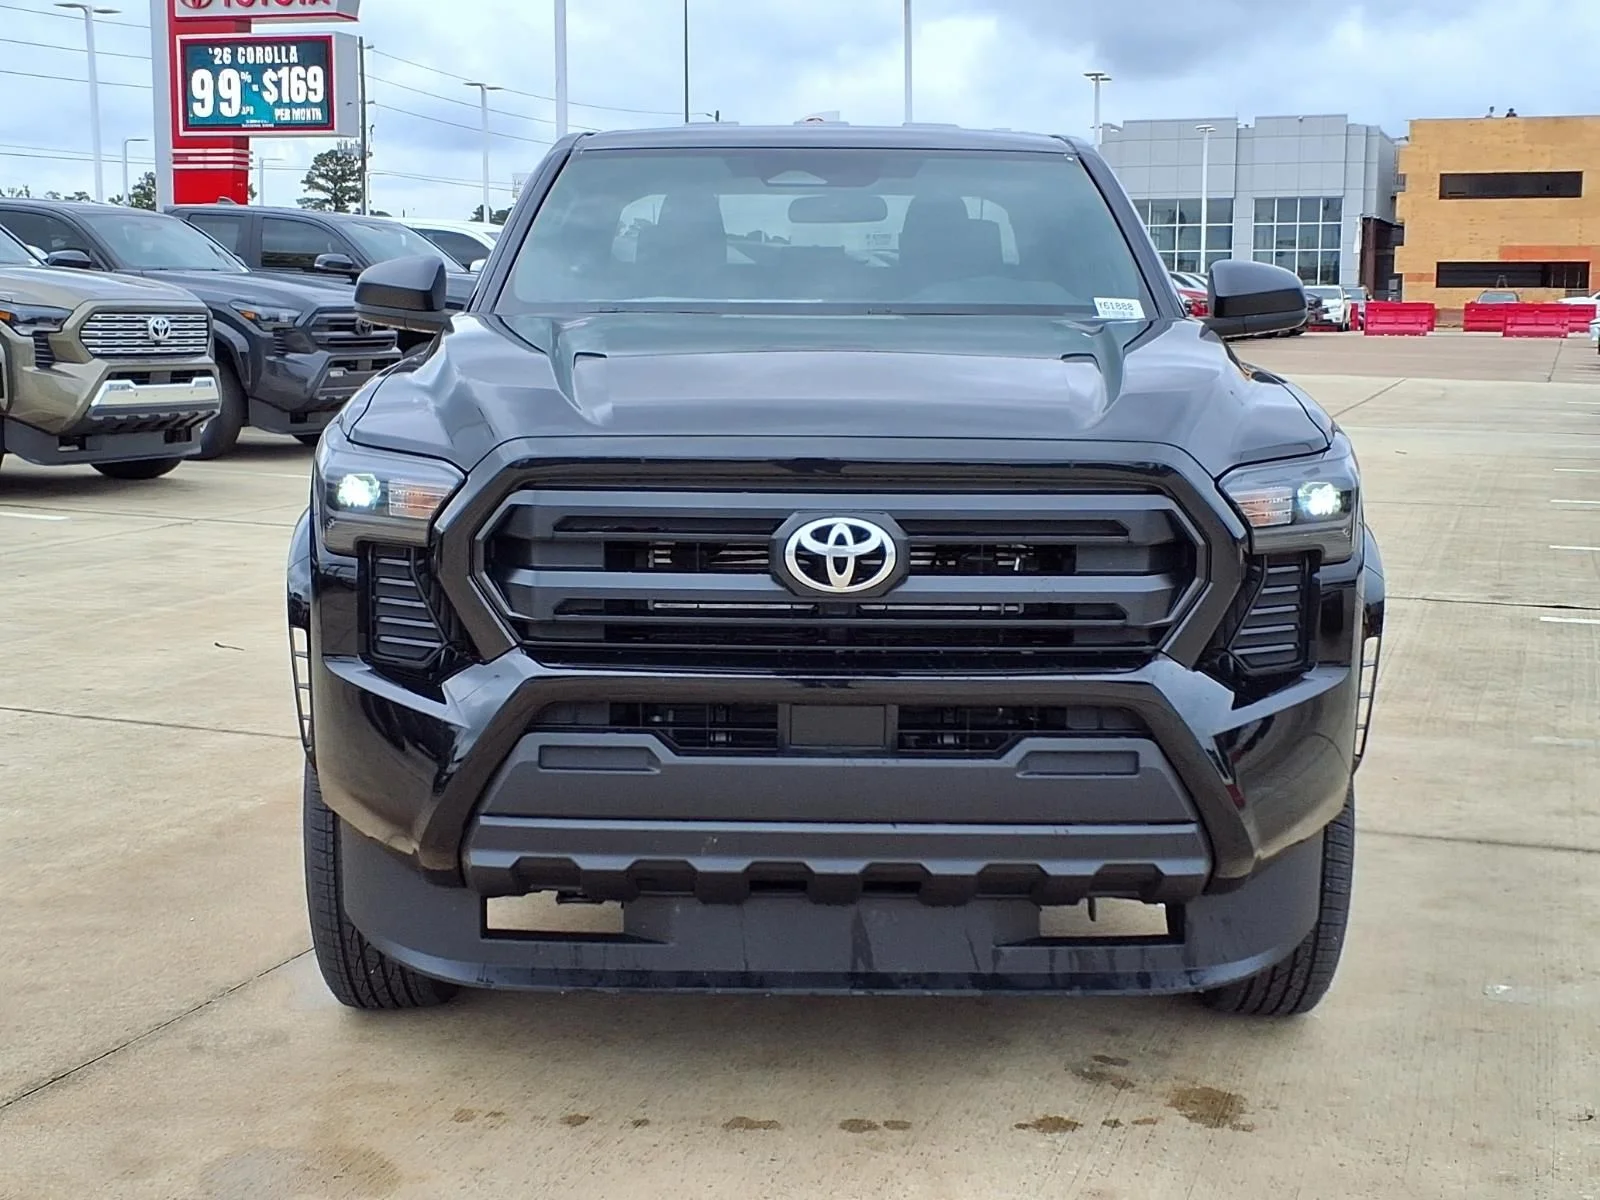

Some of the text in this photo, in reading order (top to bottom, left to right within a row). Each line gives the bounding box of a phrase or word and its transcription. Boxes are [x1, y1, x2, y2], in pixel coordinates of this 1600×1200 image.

[237, 45, 299, 64] COROLLA
[262, 65, 324, 106] $169
[274, 107, 322, 121] PER MONTH
